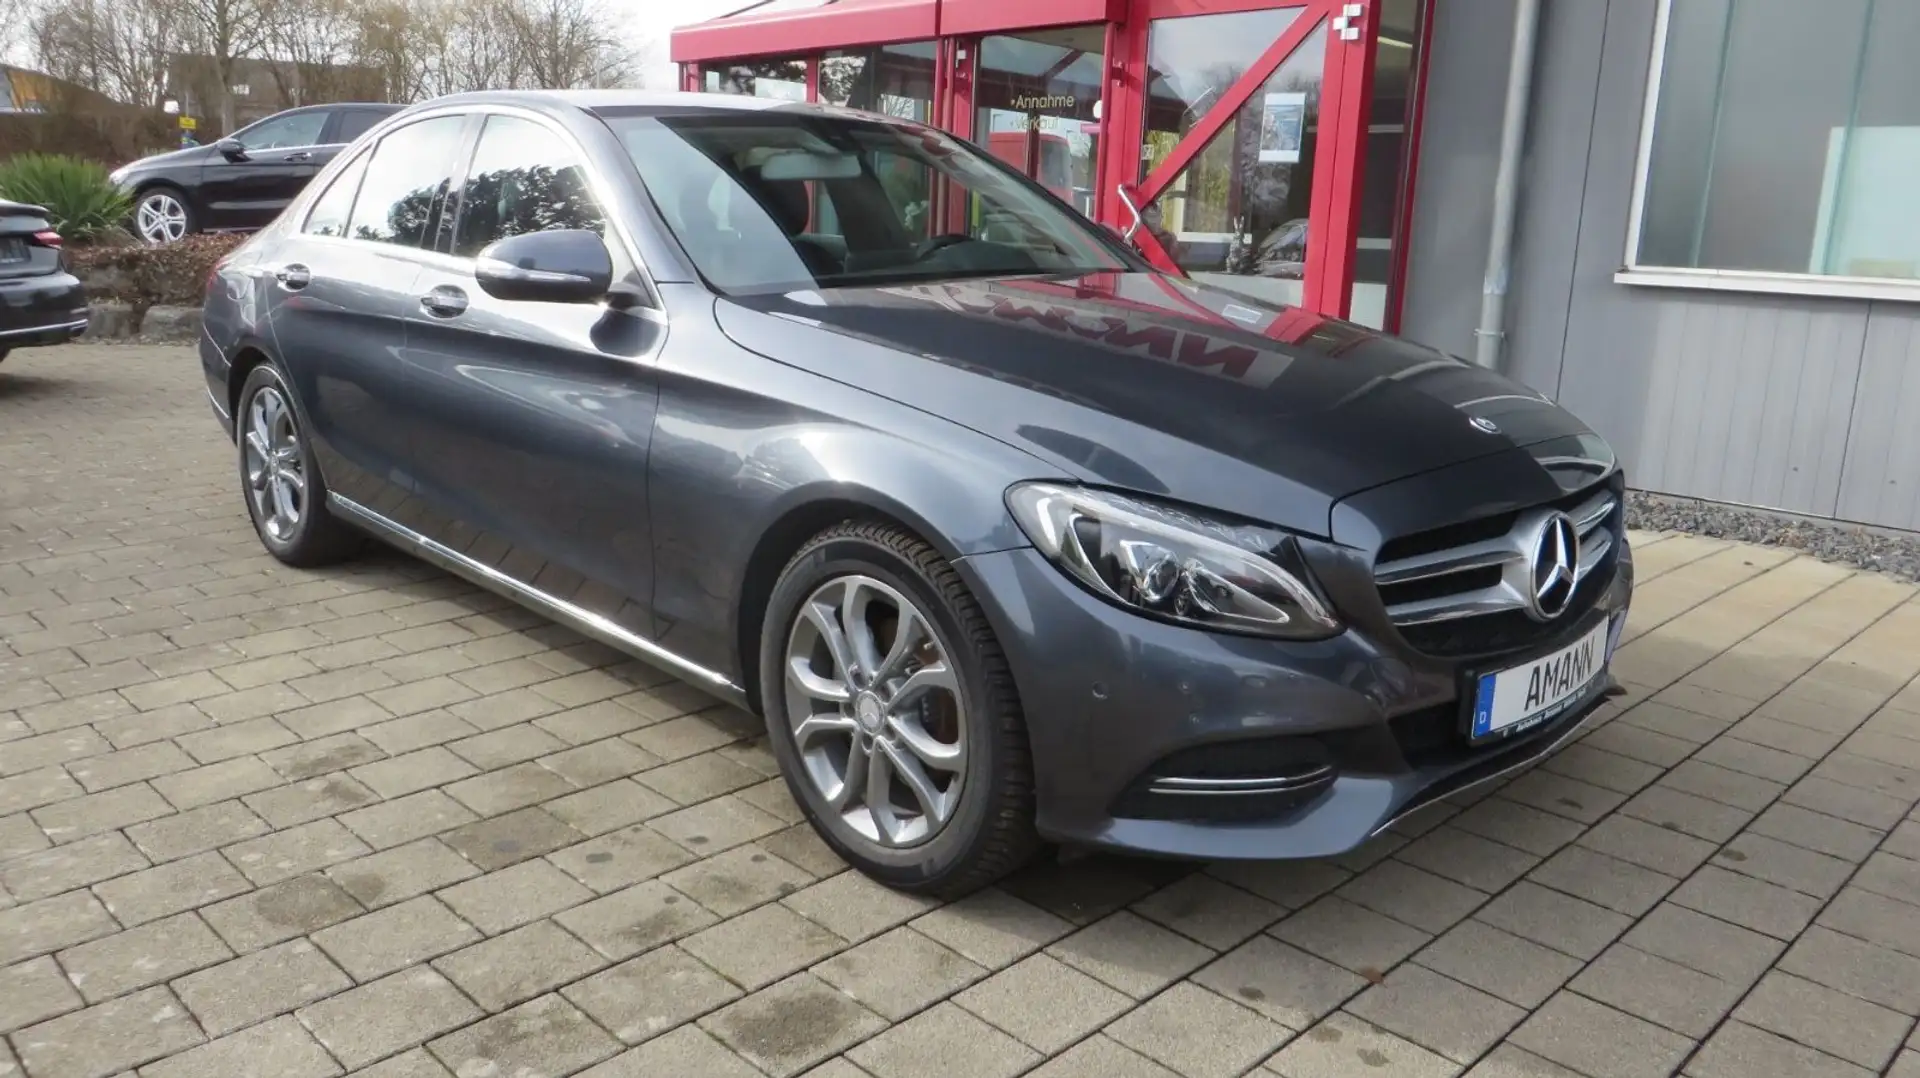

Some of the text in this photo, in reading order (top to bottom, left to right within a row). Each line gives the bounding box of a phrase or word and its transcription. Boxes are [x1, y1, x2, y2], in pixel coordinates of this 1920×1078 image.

[1015, 94, 1075, 109] Annahme
[1524, 635, 1595, 712] AMANN
[1479, 711, 1487, 725] D
